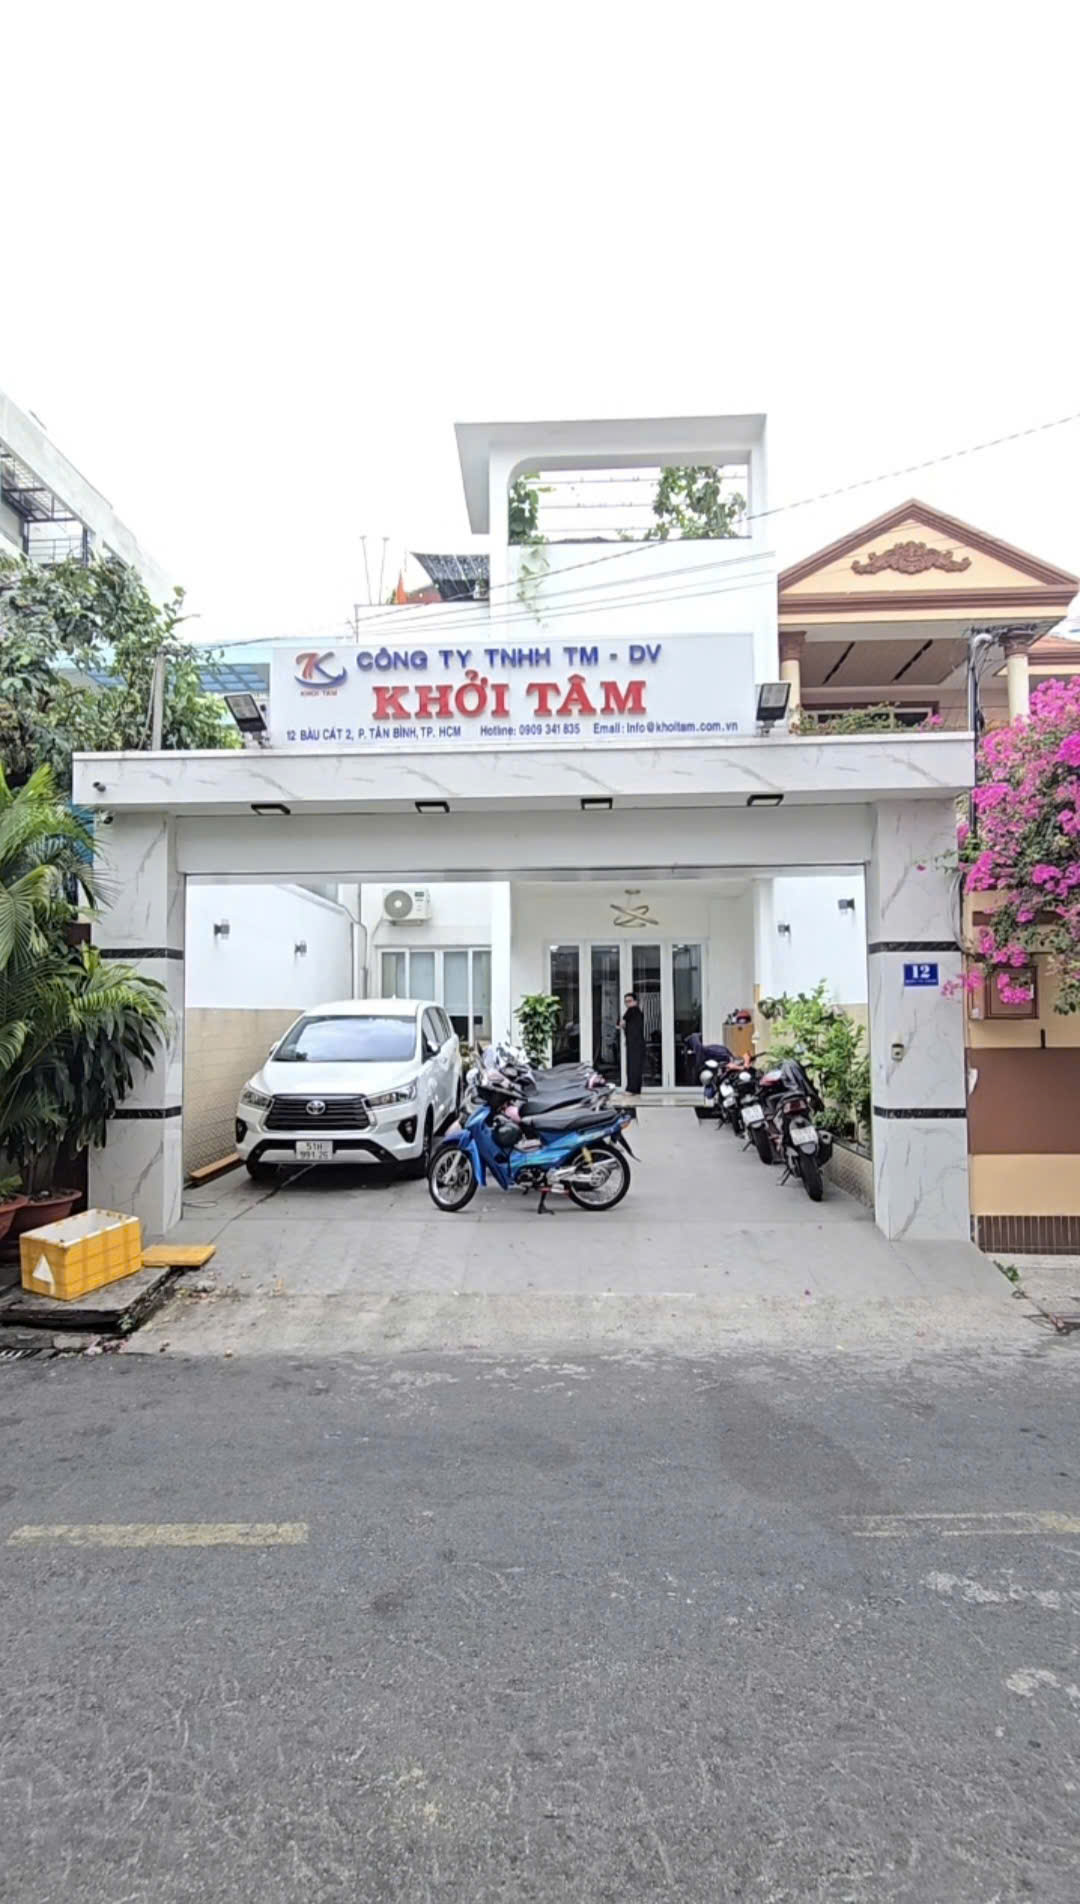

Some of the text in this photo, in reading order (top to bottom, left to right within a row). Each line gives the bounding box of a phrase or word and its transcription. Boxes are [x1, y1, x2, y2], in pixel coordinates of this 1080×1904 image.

[357, 647, 428, 671] CÔNG
[439, 649, 472, 669] TY
[484, 647, 551, 668] TNHH
[563, 646, 598, 666] TM
[629, 644, 662, 665] DV
[372, 669, 647, 720] KHỞI TÂM
[287, 730, 296, 741] 12
[323, 725, 343, 740] CÁT
[358, 730, 367, 740] P.
[370, 725, 390, 739] TÂN
[439, 725, 461, 738] HCM
[480, 722, 581, 737] Hotline: 0909 341 835
[912, 964, 930, 978] 12
